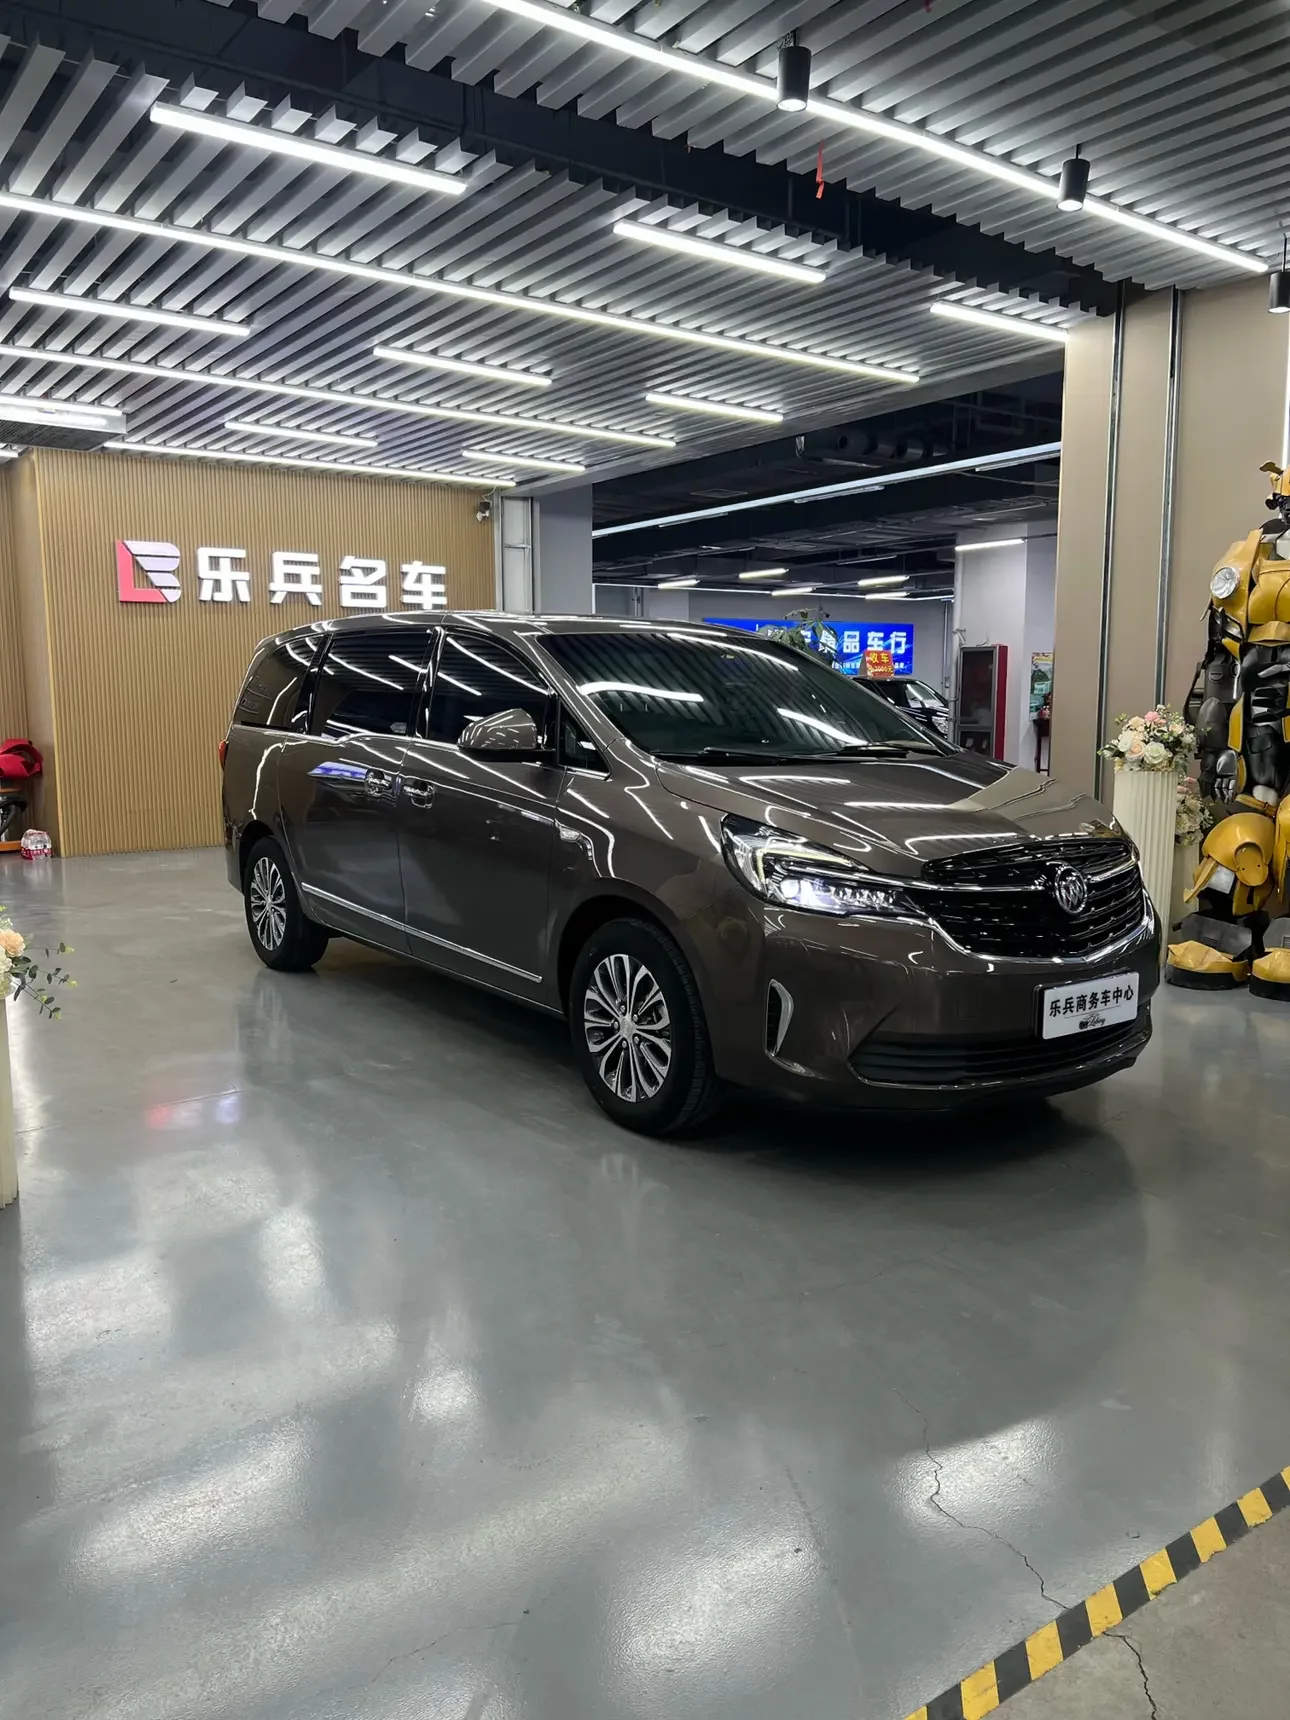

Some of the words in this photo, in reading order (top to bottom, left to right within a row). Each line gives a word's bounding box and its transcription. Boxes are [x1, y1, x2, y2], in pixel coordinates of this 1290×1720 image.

[197, 547, 447, 609] 乐兵名车
[1049, 985, 1134, 1017] 乐兵商务车中心
